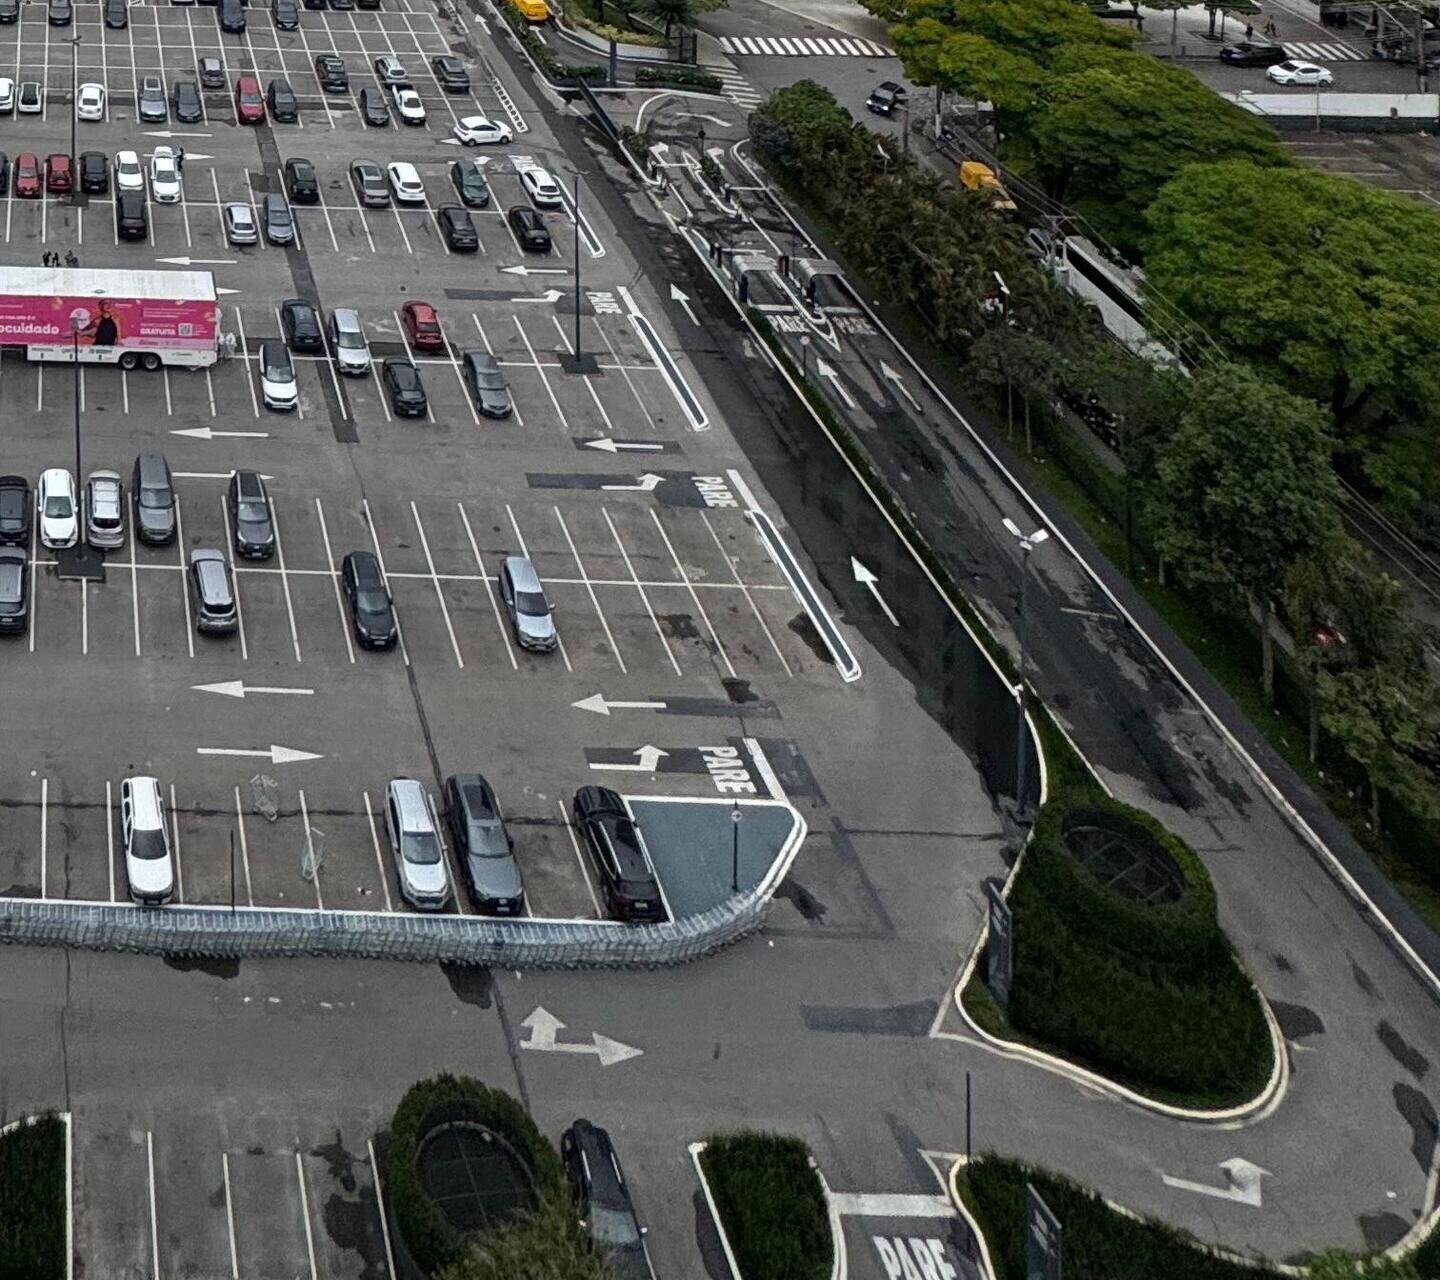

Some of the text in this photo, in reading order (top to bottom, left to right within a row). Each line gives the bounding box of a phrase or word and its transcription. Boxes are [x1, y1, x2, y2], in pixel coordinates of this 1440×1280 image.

[585, 291, 622, 314] PARE
[765, 315, 811, 332] PARE
[691, 476, 739, 507] PARE
[698, 746, 756, 793] PARE
[873, 1236, 957, 1280] PARE
